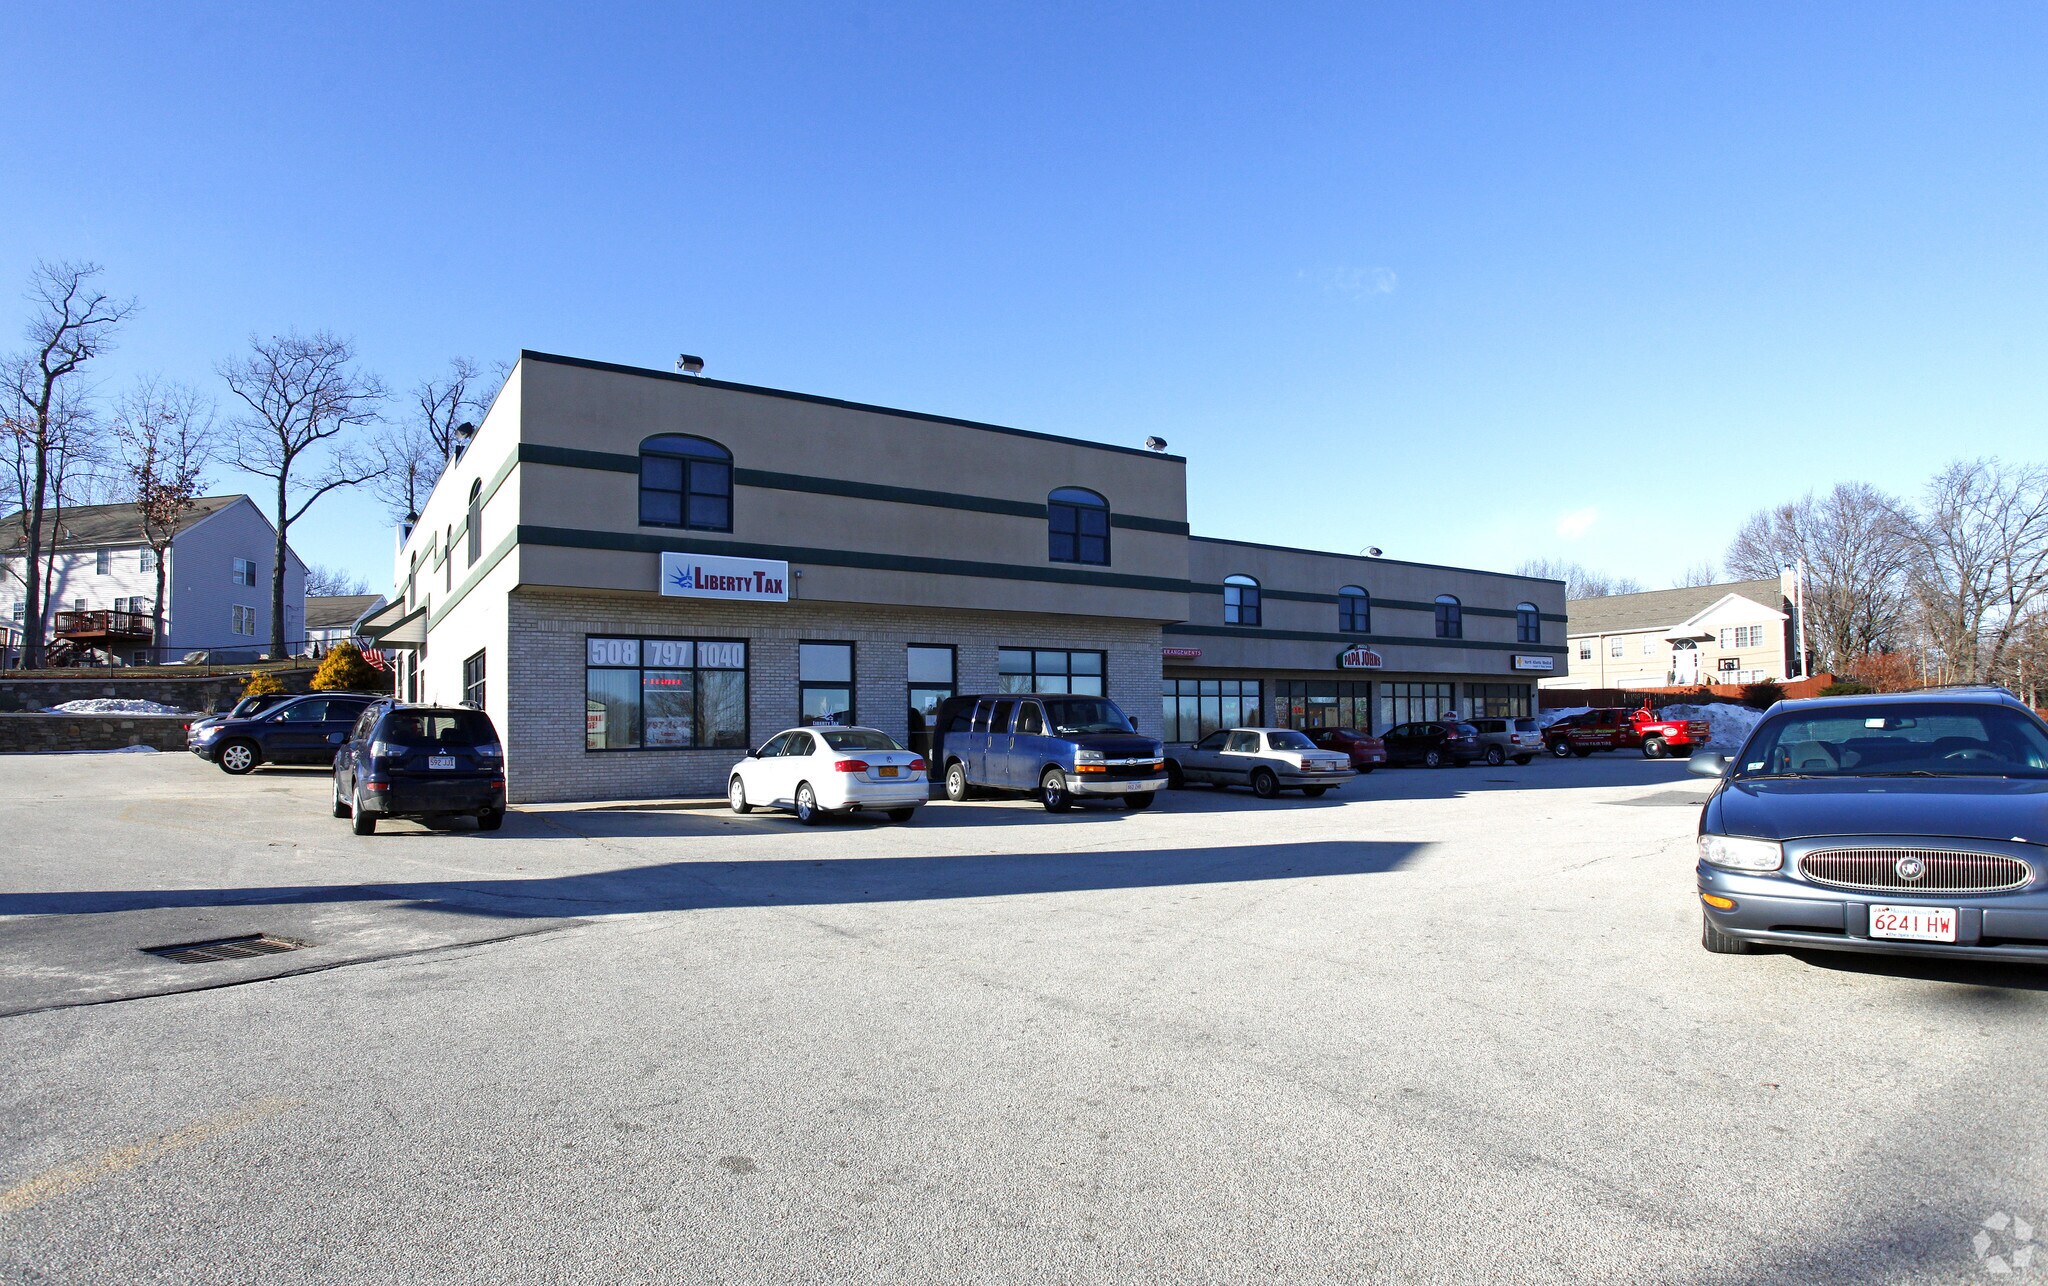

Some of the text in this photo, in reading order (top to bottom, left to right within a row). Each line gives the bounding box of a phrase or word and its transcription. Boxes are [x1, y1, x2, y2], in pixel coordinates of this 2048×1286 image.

[695, 567, 783, 594] LIBERTY TAX
[592, 640, 742, 667] 508 797 1040
[1344, 651, 1360, 666] PAPA
[1875, 914, 1950, 934] 6241 HW
